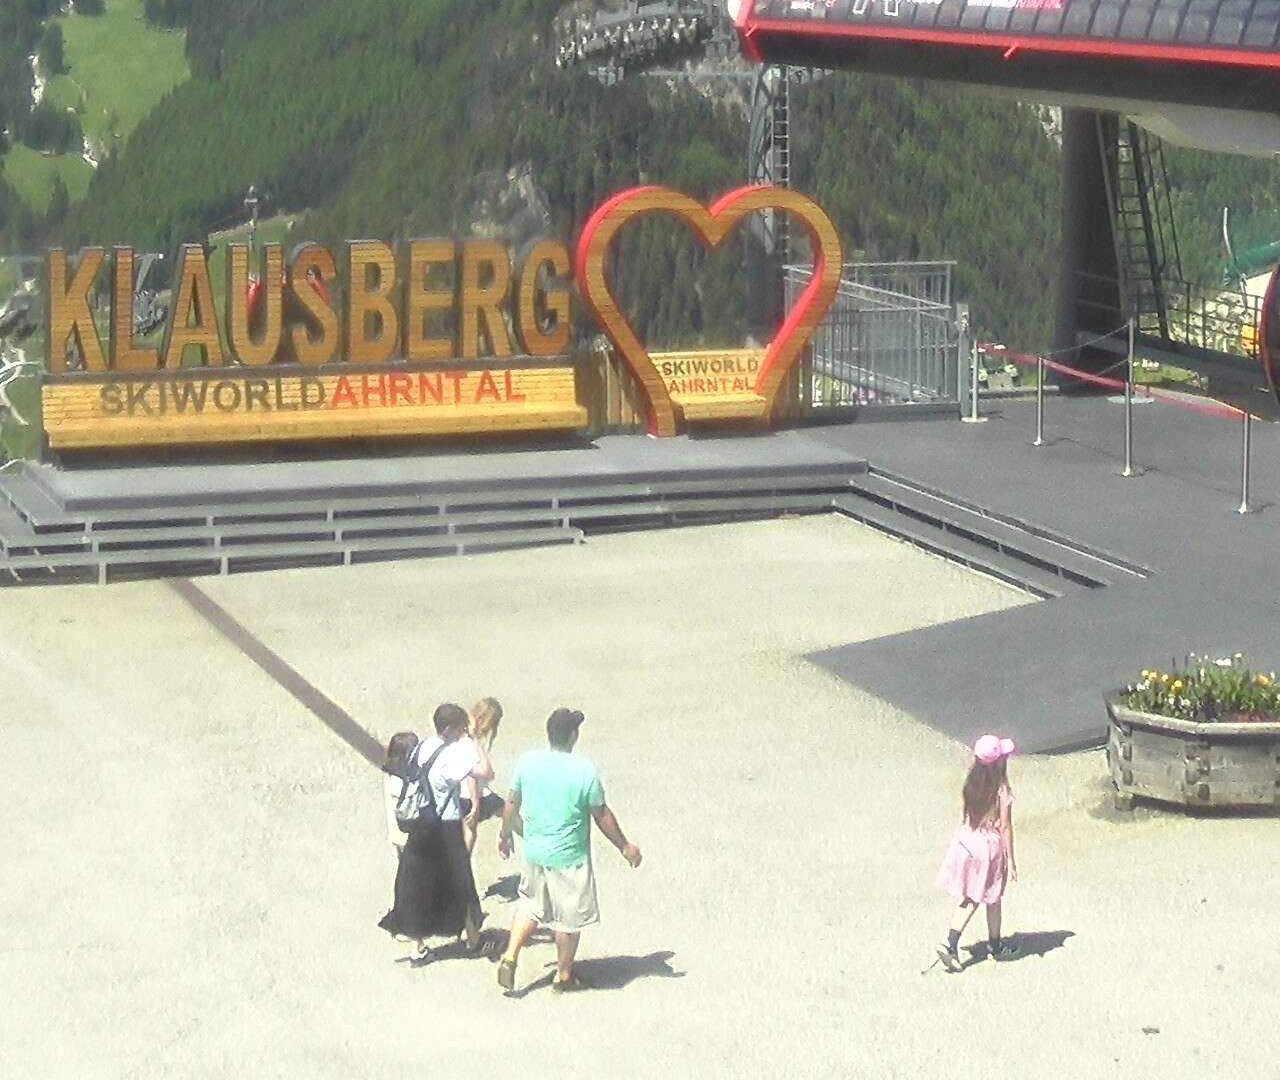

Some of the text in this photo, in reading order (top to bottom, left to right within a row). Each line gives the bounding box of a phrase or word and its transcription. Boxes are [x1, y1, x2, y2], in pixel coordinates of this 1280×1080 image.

[47, 238, 572, 375] KLAUSBERG
[661, 356, 759, 376] SKIWORLD
[669, 375, 755, 394] AHRNTAL
